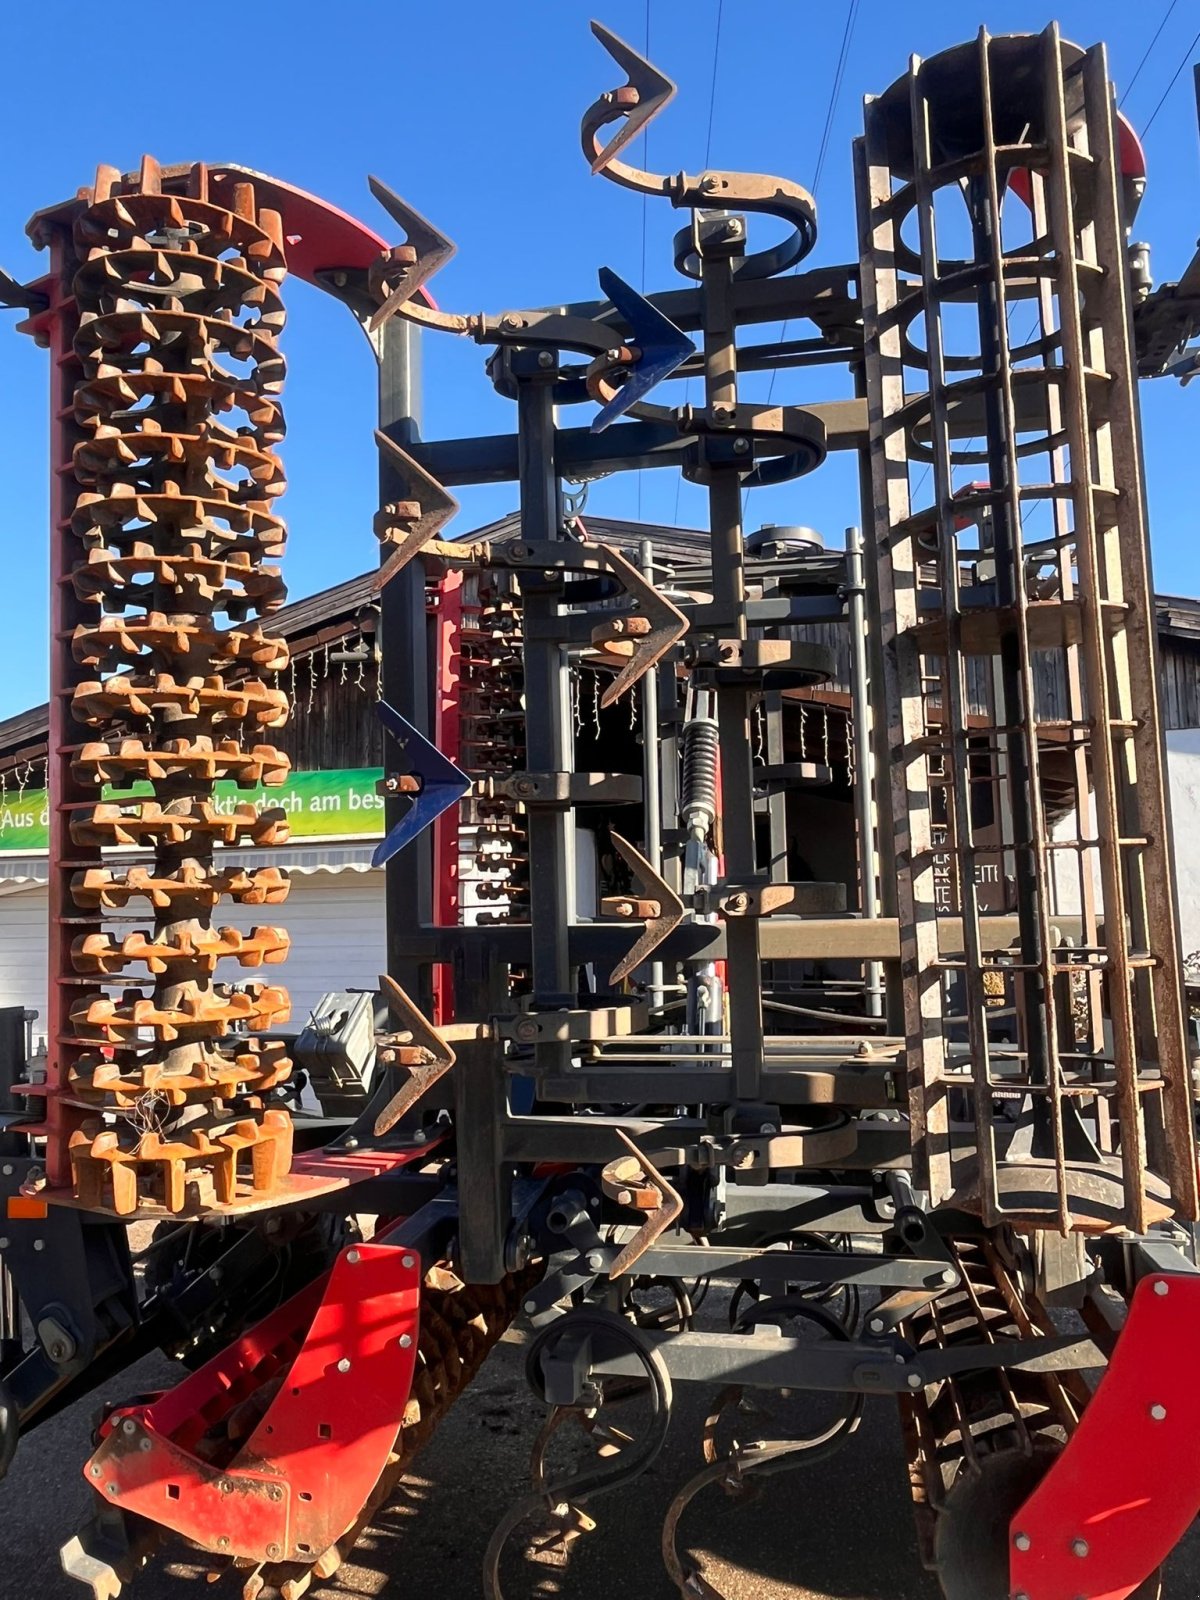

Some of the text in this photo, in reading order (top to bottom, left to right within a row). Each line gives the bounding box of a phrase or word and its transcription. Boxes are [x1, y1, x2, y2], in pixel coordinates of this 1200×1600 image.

[3, 809, 34, 828] Aus
[310, 794, 341, 812] am
[348, 788, 385, 810] bes
